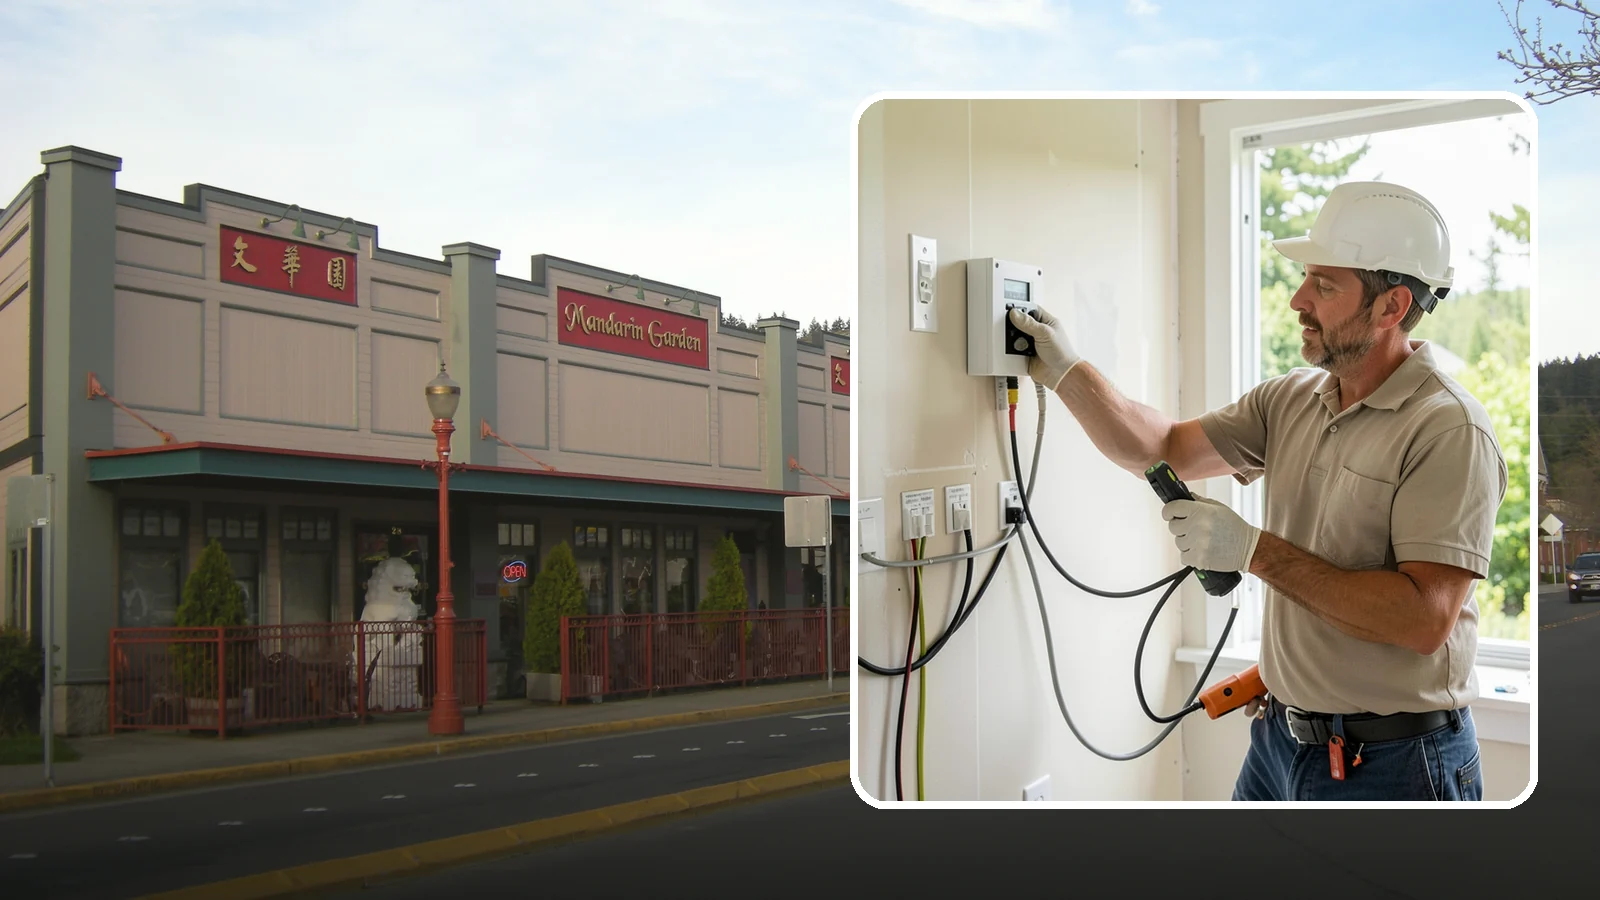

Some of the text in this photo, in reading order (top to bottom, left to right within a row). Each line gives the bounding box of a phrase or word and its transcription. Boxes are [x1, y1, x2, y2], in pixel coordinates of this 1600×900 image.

[565, 302, 701, 352] Mandarin Garden
[503, 565, 527, 578] OPEN
